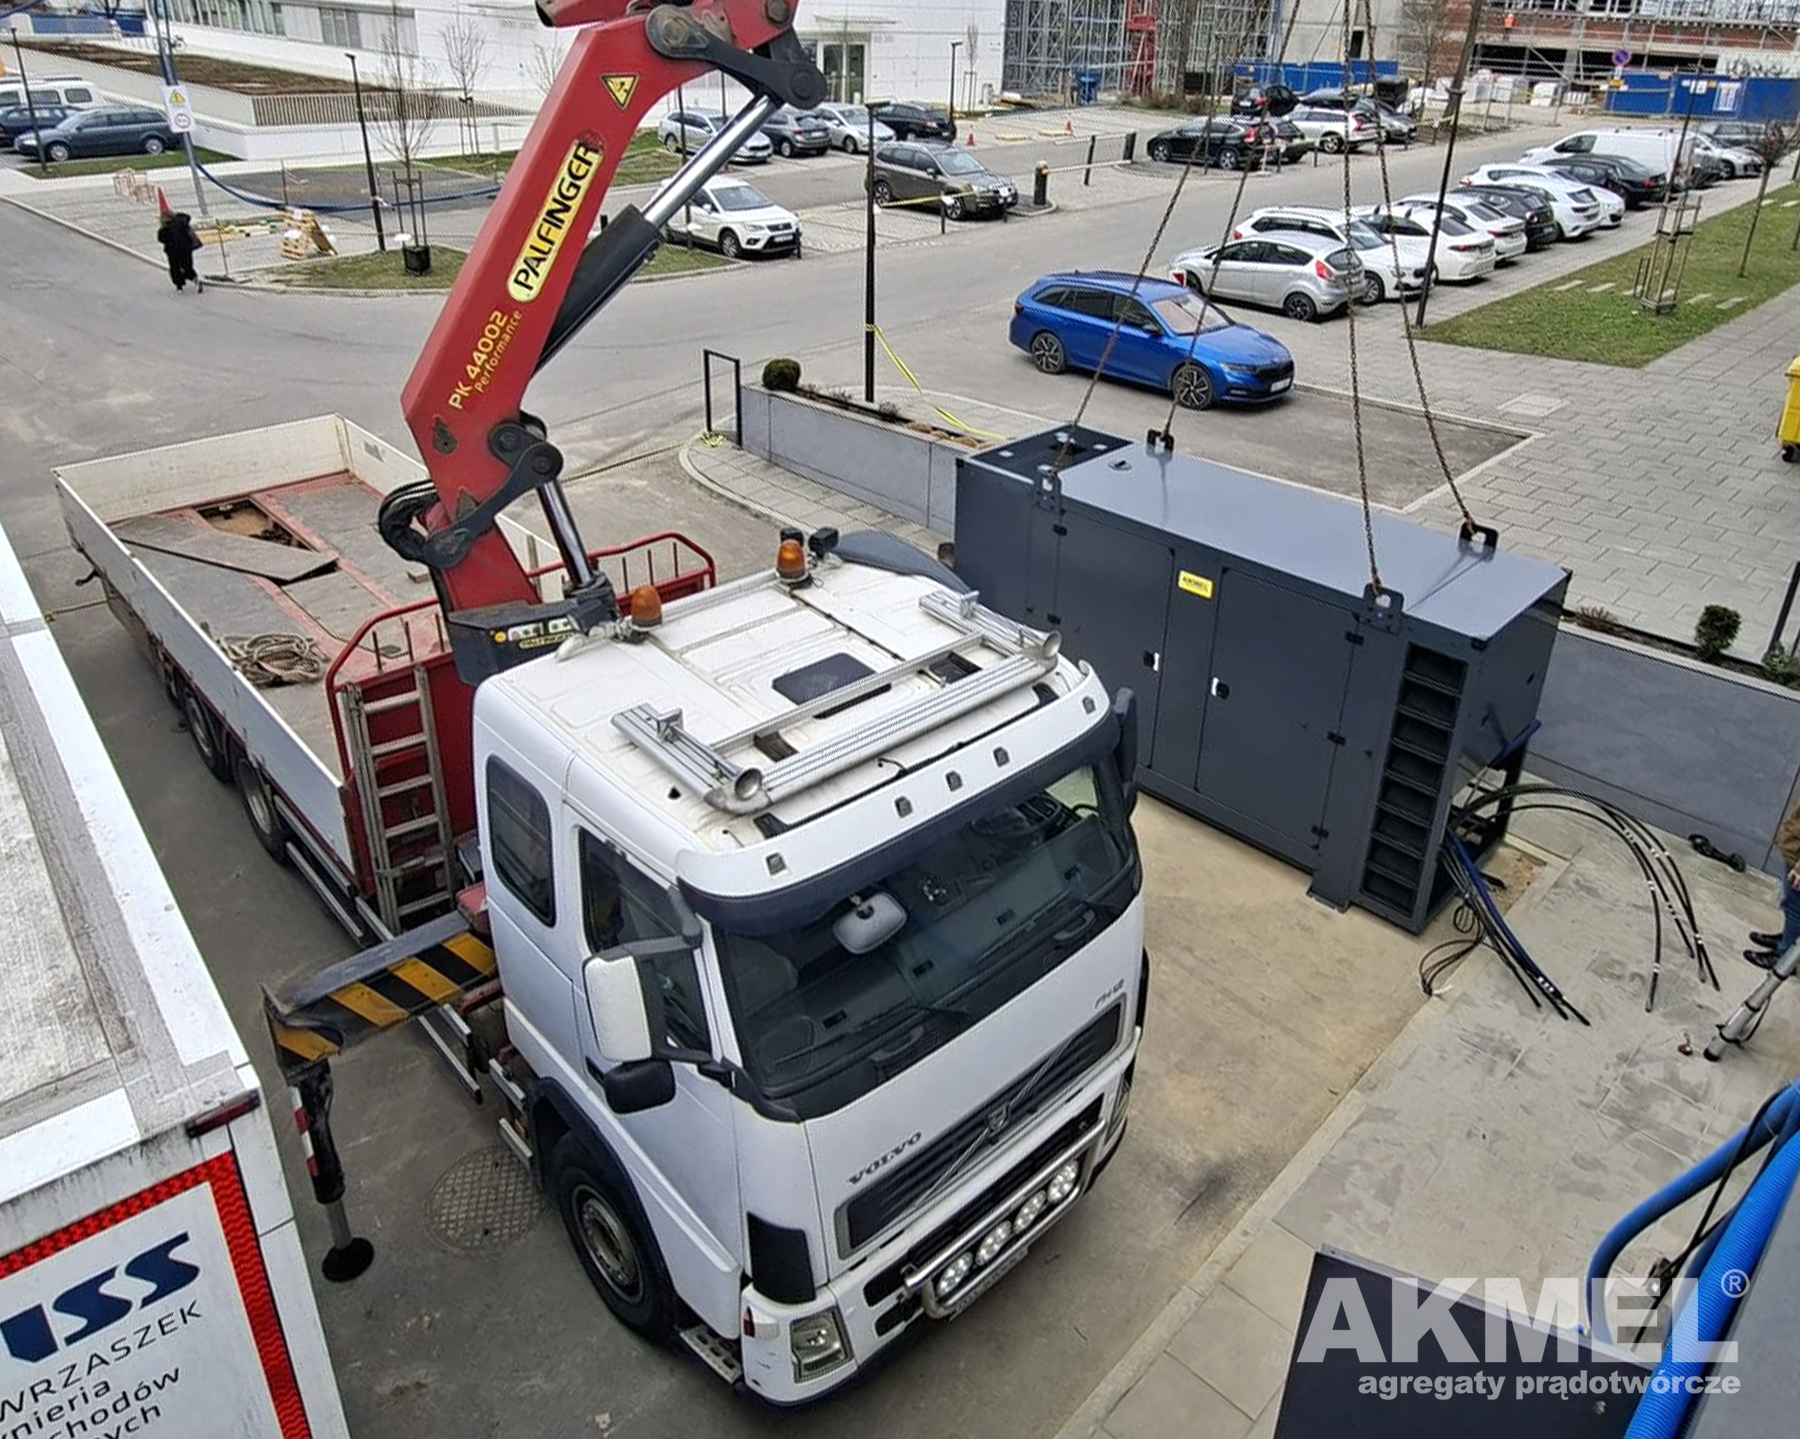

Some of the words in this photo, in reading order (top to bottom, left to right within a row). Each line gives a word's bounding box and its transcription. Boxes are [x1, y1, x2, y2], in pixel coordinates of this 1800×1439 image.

[513, 140, 600, 292] PALFINGER
[448, 375, 472, 409] PK
[466, 310, 509, 379] 44002
[474, 309, 523, 393] Performance
[848, 1131, 921, 1185] VOLVO
